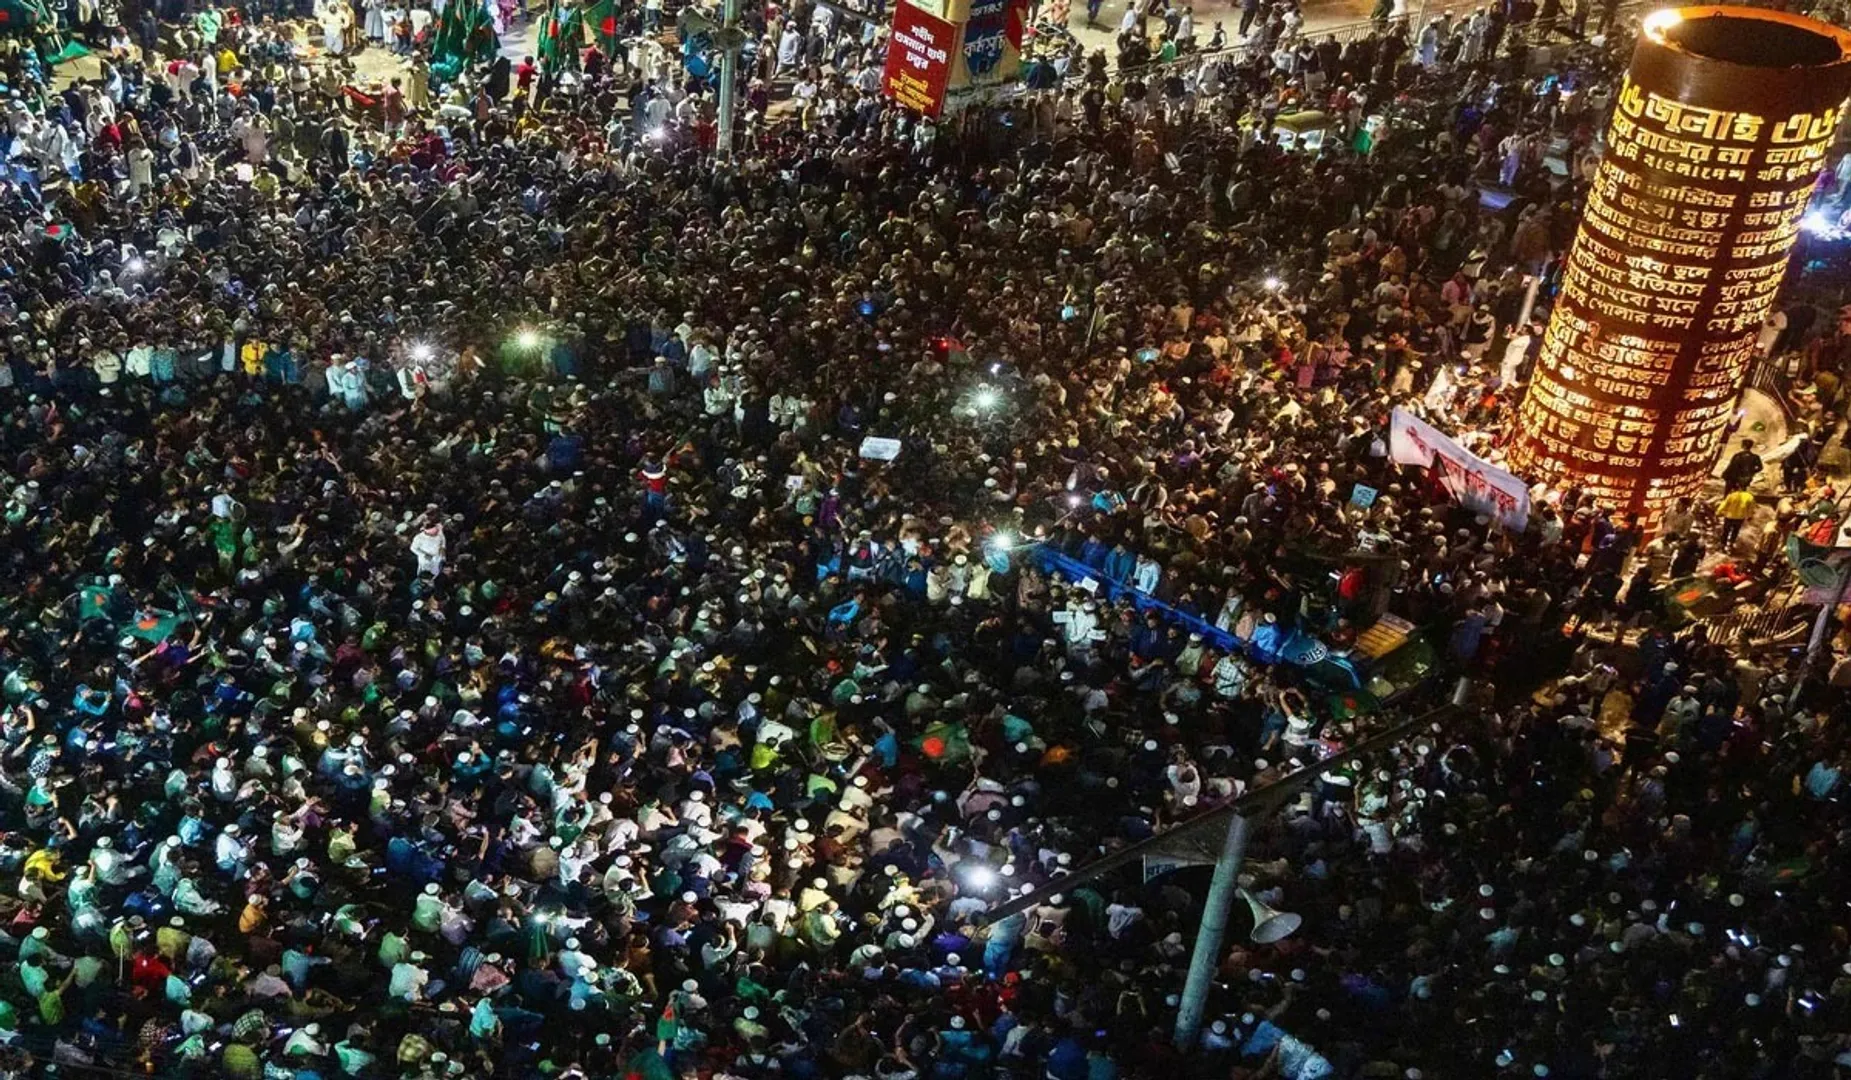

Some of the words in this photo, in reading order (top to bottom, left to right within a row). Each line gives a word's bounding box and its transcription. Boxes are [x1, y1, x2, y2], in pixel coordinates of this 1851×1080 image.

[894, 31, 926, 53] ওসমান
[911, 24, 935, 45] শহীদ
[906, 51, 929, 71] চত্বর
[1644, 92, 1765, 142] জুলাই
[1770, 108, 1836, 144] ৩৬
[1636, 126, 1714, 165] বাপের
[1717, 146, 1754, 165] না
[1643, 153, 1746, 182] বাংলাদেশ
[1681, 210, 1732, 228] মৃত্যু
[1627, 231, 1718, 260] রাজাকার
[1628, 268, 1708, 297] ইতিহাস
[1721, 281, 1754, 302] খুনি
[1673, 265, 1713, 281] ভুলে
[1591, 275, 1652, 309] রাখবো
[1656, 295, 1701, 315] মনে
[1713, 299, 1740, 316] সে
[1588, 295, 1650, 325] পোলার
[1652, 314, 1694, 330] লাশ
[1706, 317, 1731, 332] যে
[1604, 333, 1681, 353] বাংলাদেশ
